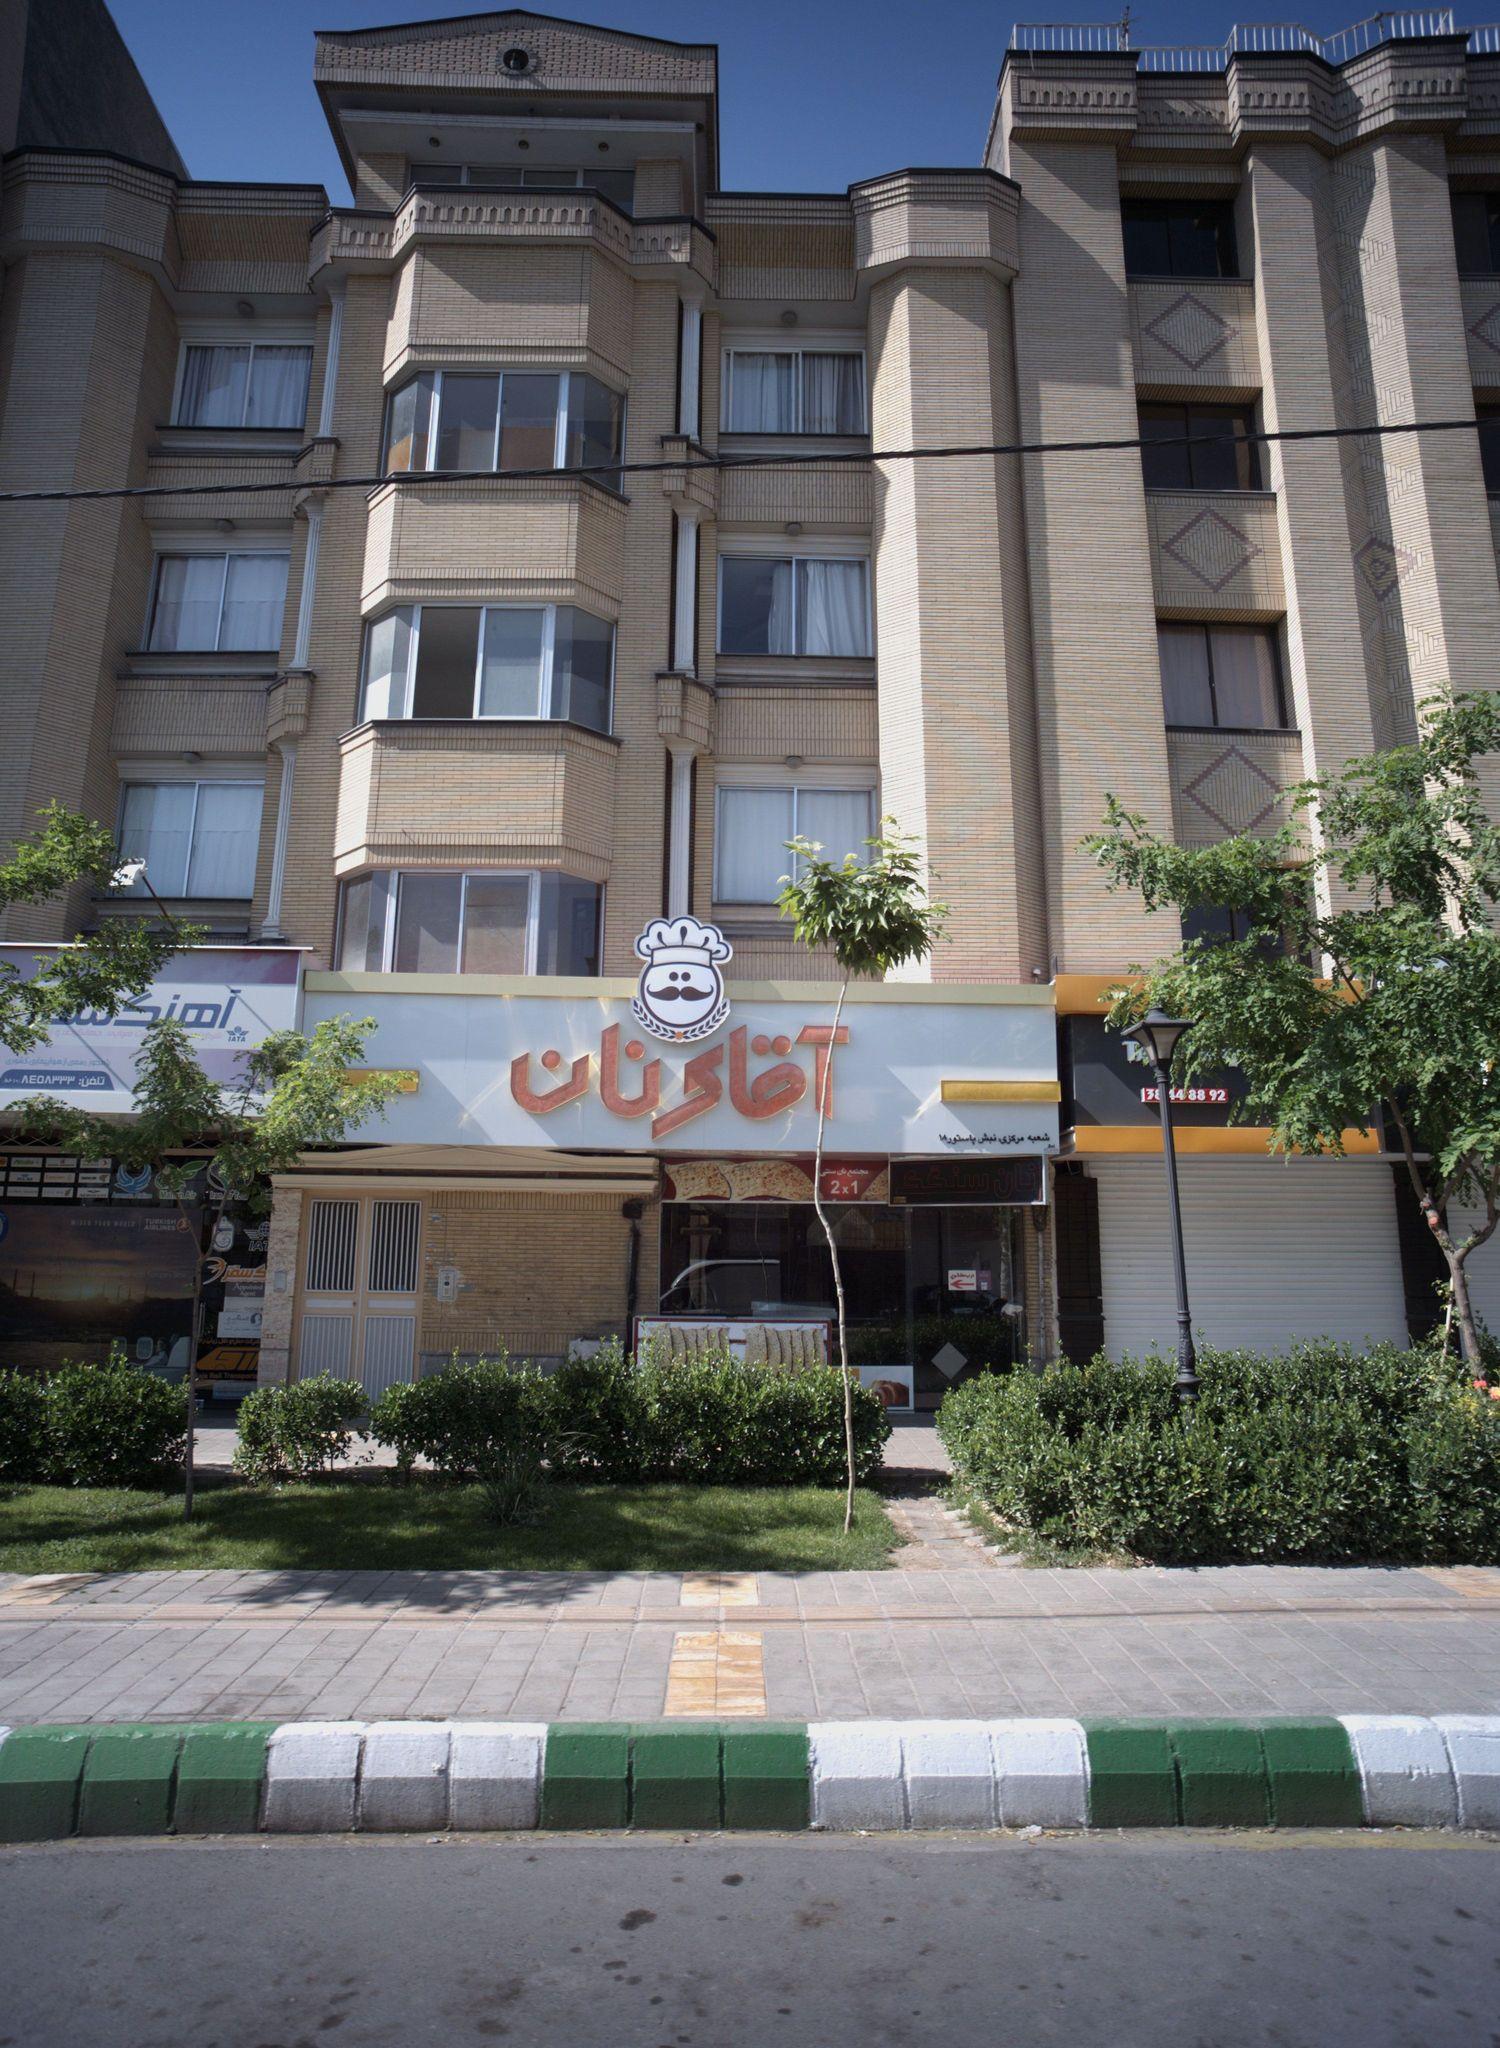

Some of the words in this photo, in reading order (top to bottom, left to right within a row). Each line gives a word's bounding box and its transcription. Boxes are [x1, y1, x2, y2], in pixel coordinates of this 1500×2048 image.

[510, 1023, 661, 1118] نان
[652, 1024, 849, 1140] آقای
[1209, 1089, 1226, 1101] 92
[977, 1132, 997, 1144] نبش
[1027, 1132, 1050, 1144] شعبه
